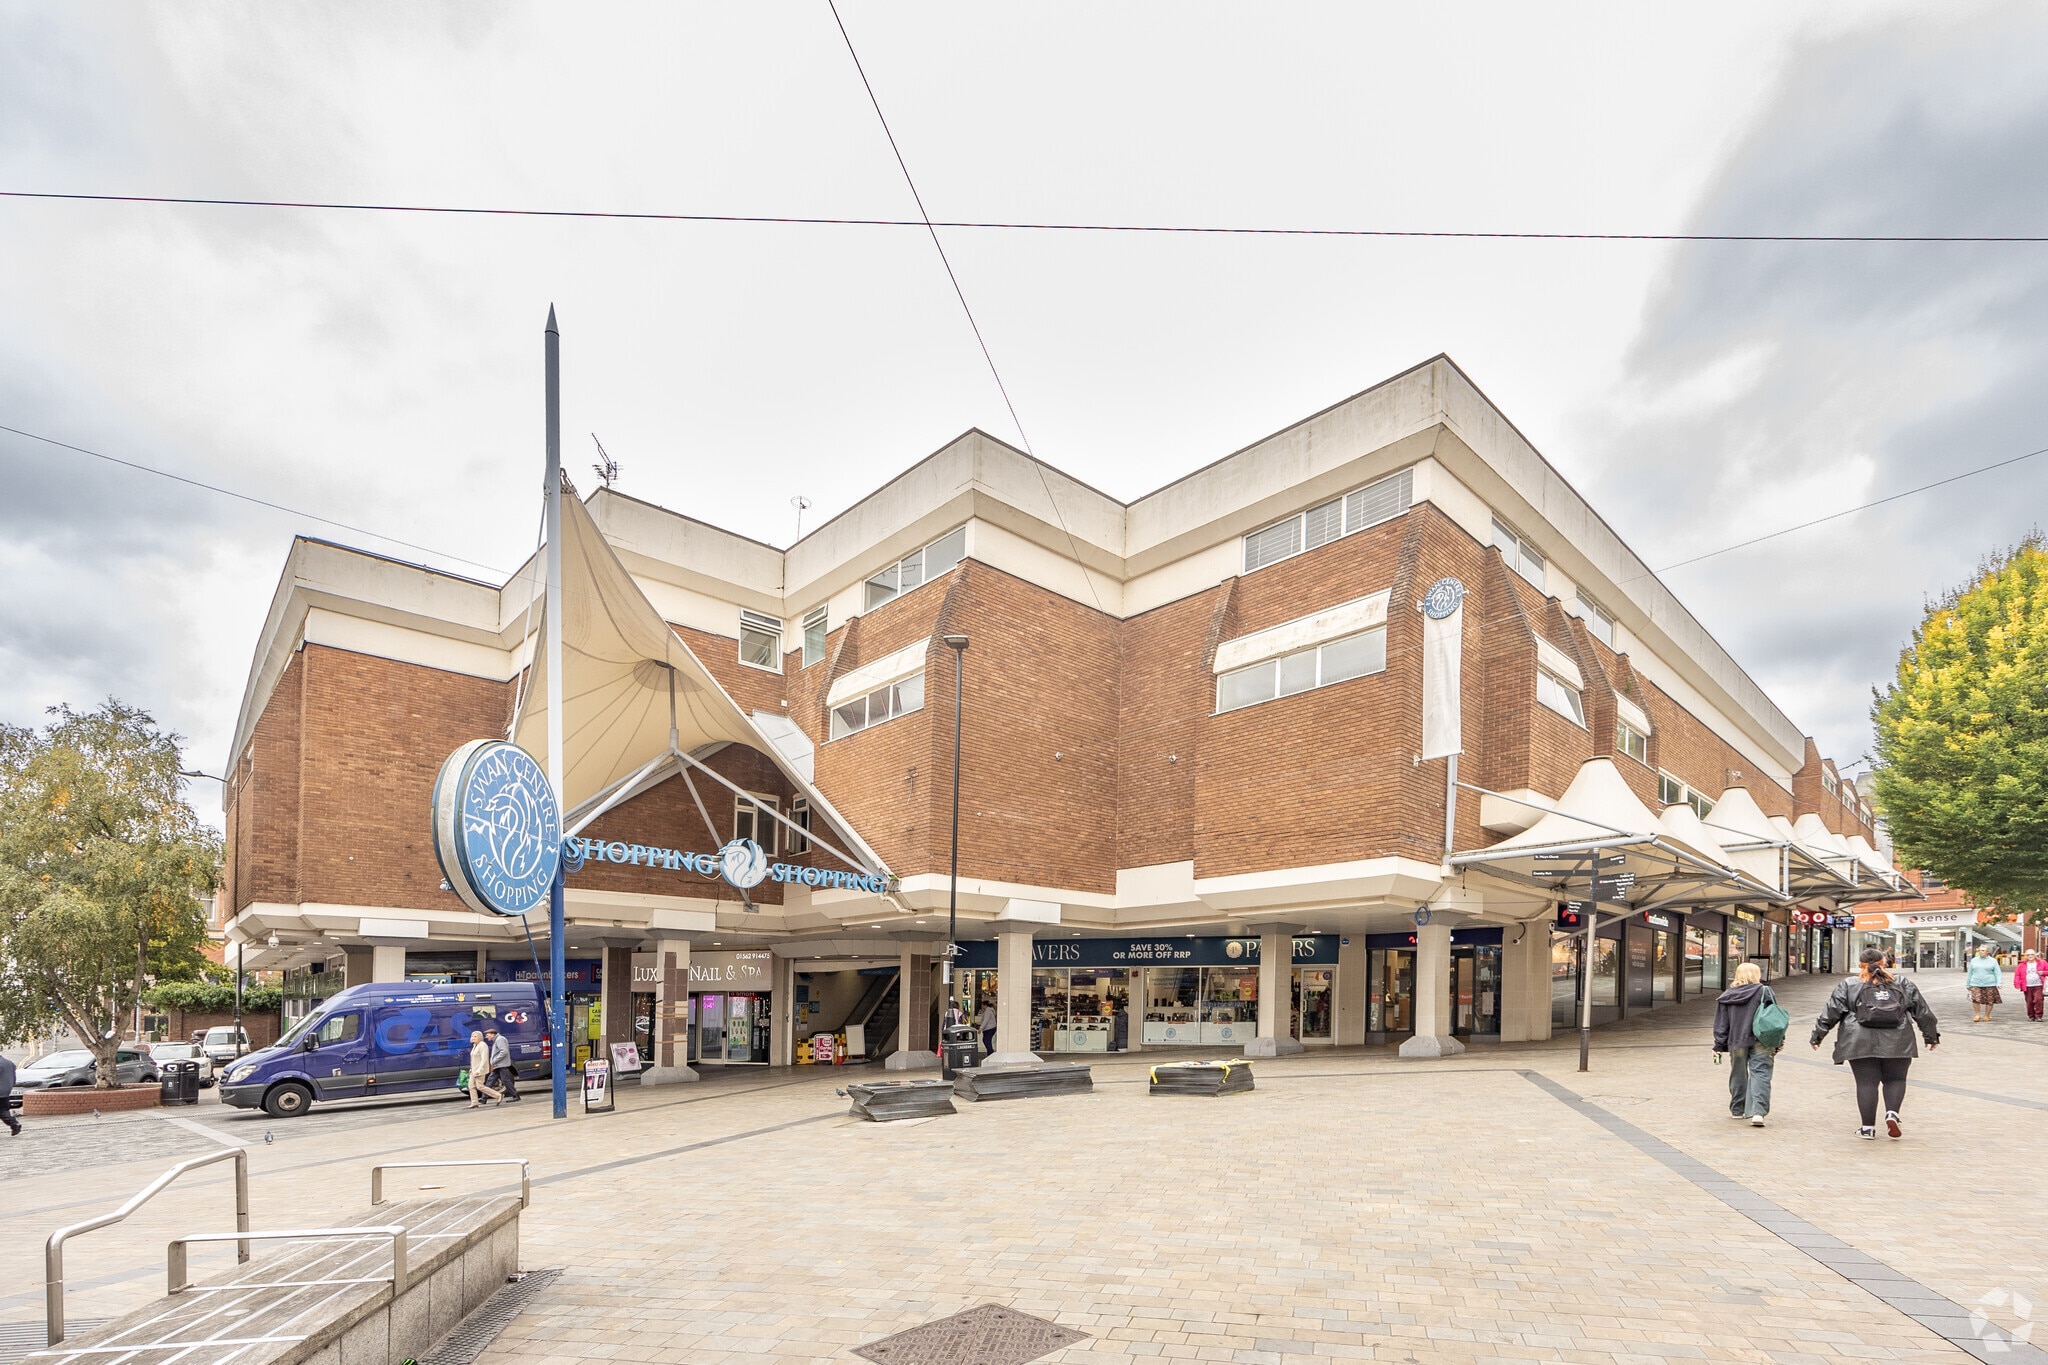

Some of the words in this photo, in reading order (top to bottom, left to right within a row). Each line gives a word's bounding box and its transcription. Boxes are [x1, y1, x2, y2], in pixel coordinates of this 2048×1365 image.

[470, 748, 510, 809] SWAN
[513, 755, 556, 834] CENTRE
[564, 836, 714, 875] SHOPPING
[474, 854, 548, 906] SHOPPING
[772, 862, 886, 893] SHOPPING
[1920, 914, 1958, 923] sense
[1032, 944, 1080, 961] AVERS
[1113, 952, 1126, 960] OR
[1128, 951, 1153, 959] MORE
[1155, 951, 1172, 959] OFF
[1174, 951, 1191, 959] RRP
[690, 965, 722, 981] NAIL
[726, 965, 737, 981] &
[740, 965, 762, 979] SPA
[504, 1011, 528, 1024] G4S
[375, 1008, 473, 1056] G4S
